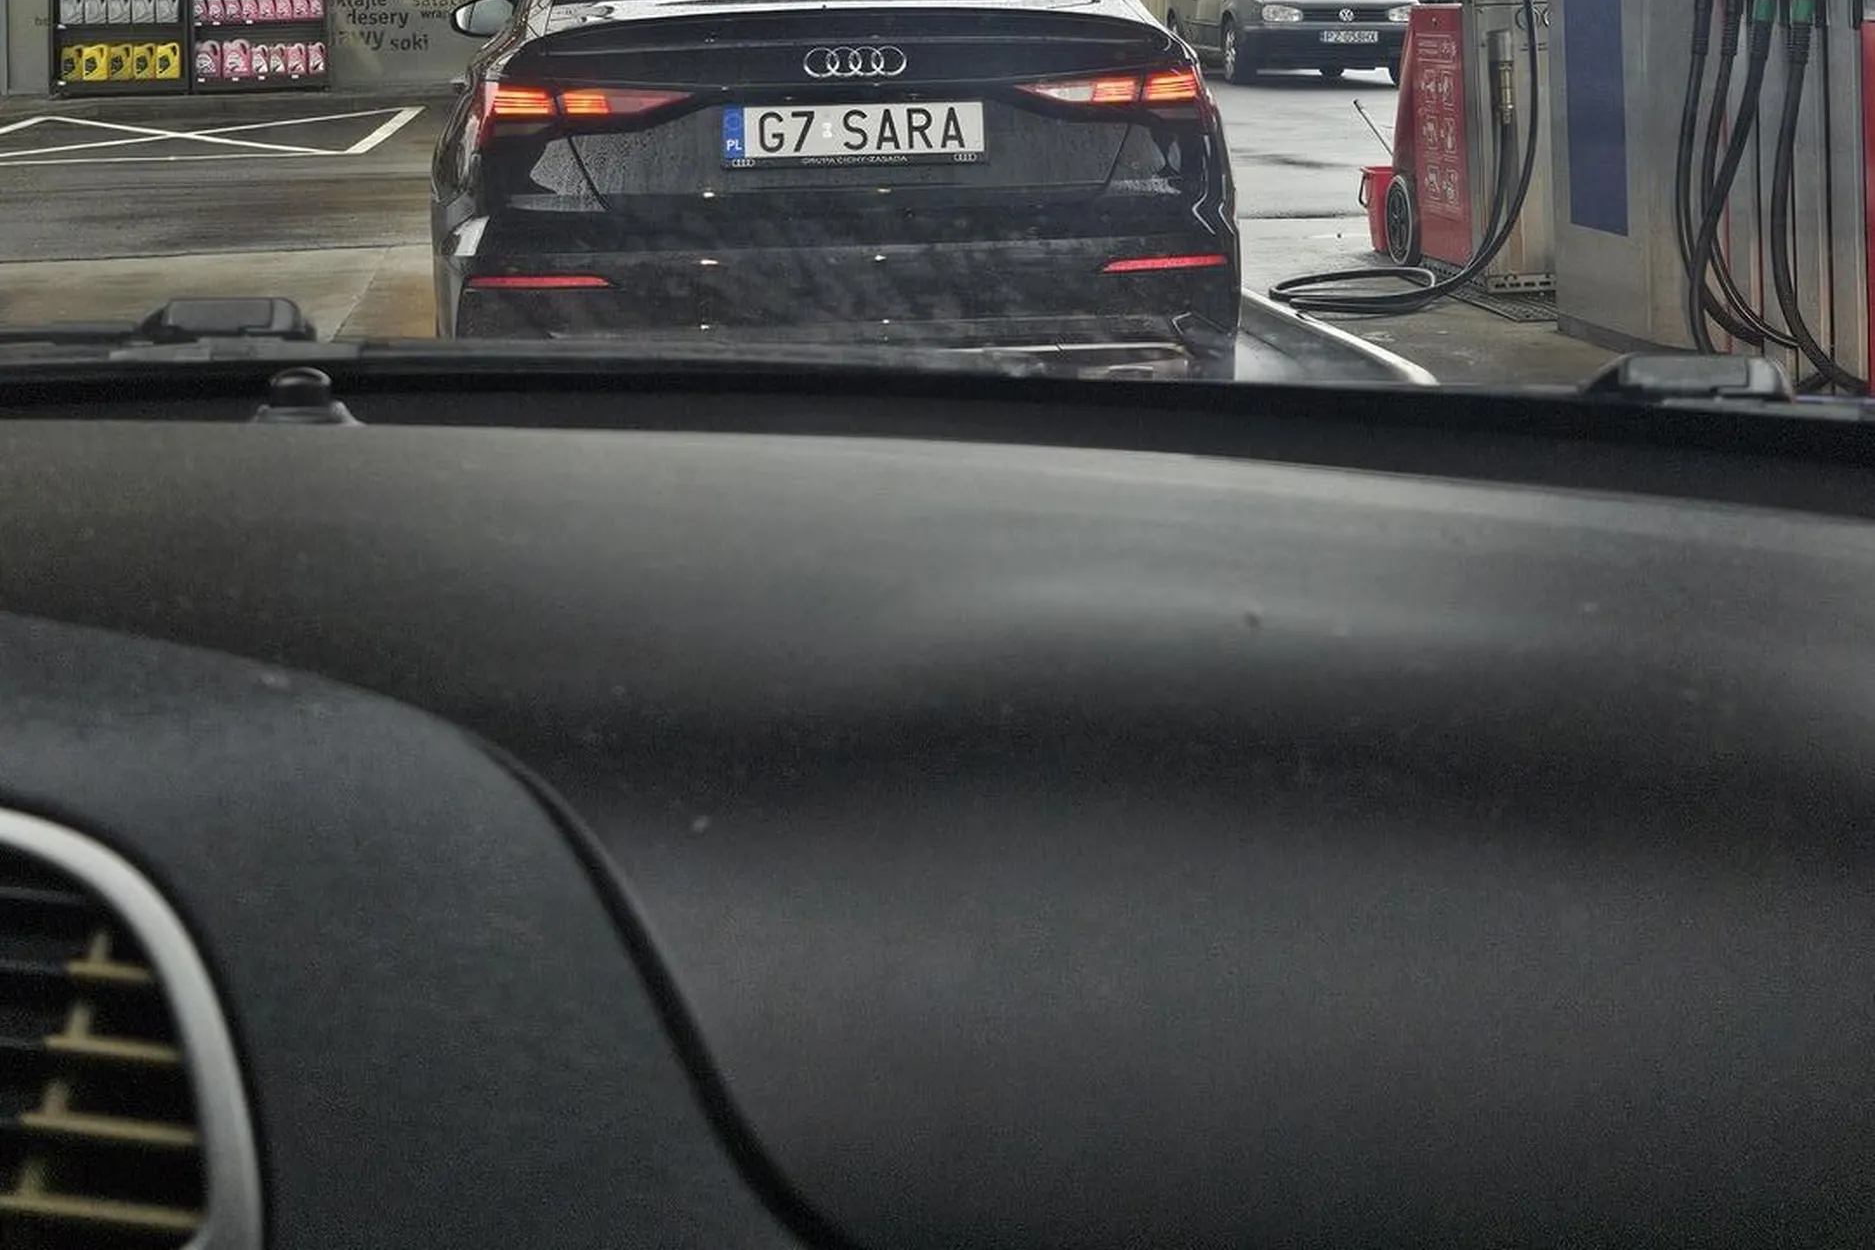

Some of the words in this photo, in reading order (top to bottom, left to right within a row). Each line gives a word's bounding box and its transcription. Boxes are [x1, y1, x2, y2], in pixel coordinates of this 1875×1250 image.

[390, 33, 429, 51] soki
[757, 110, 816, 153] G7
[841, 106, 967, 152] SARA
[726, 138, 743, 151] PL
